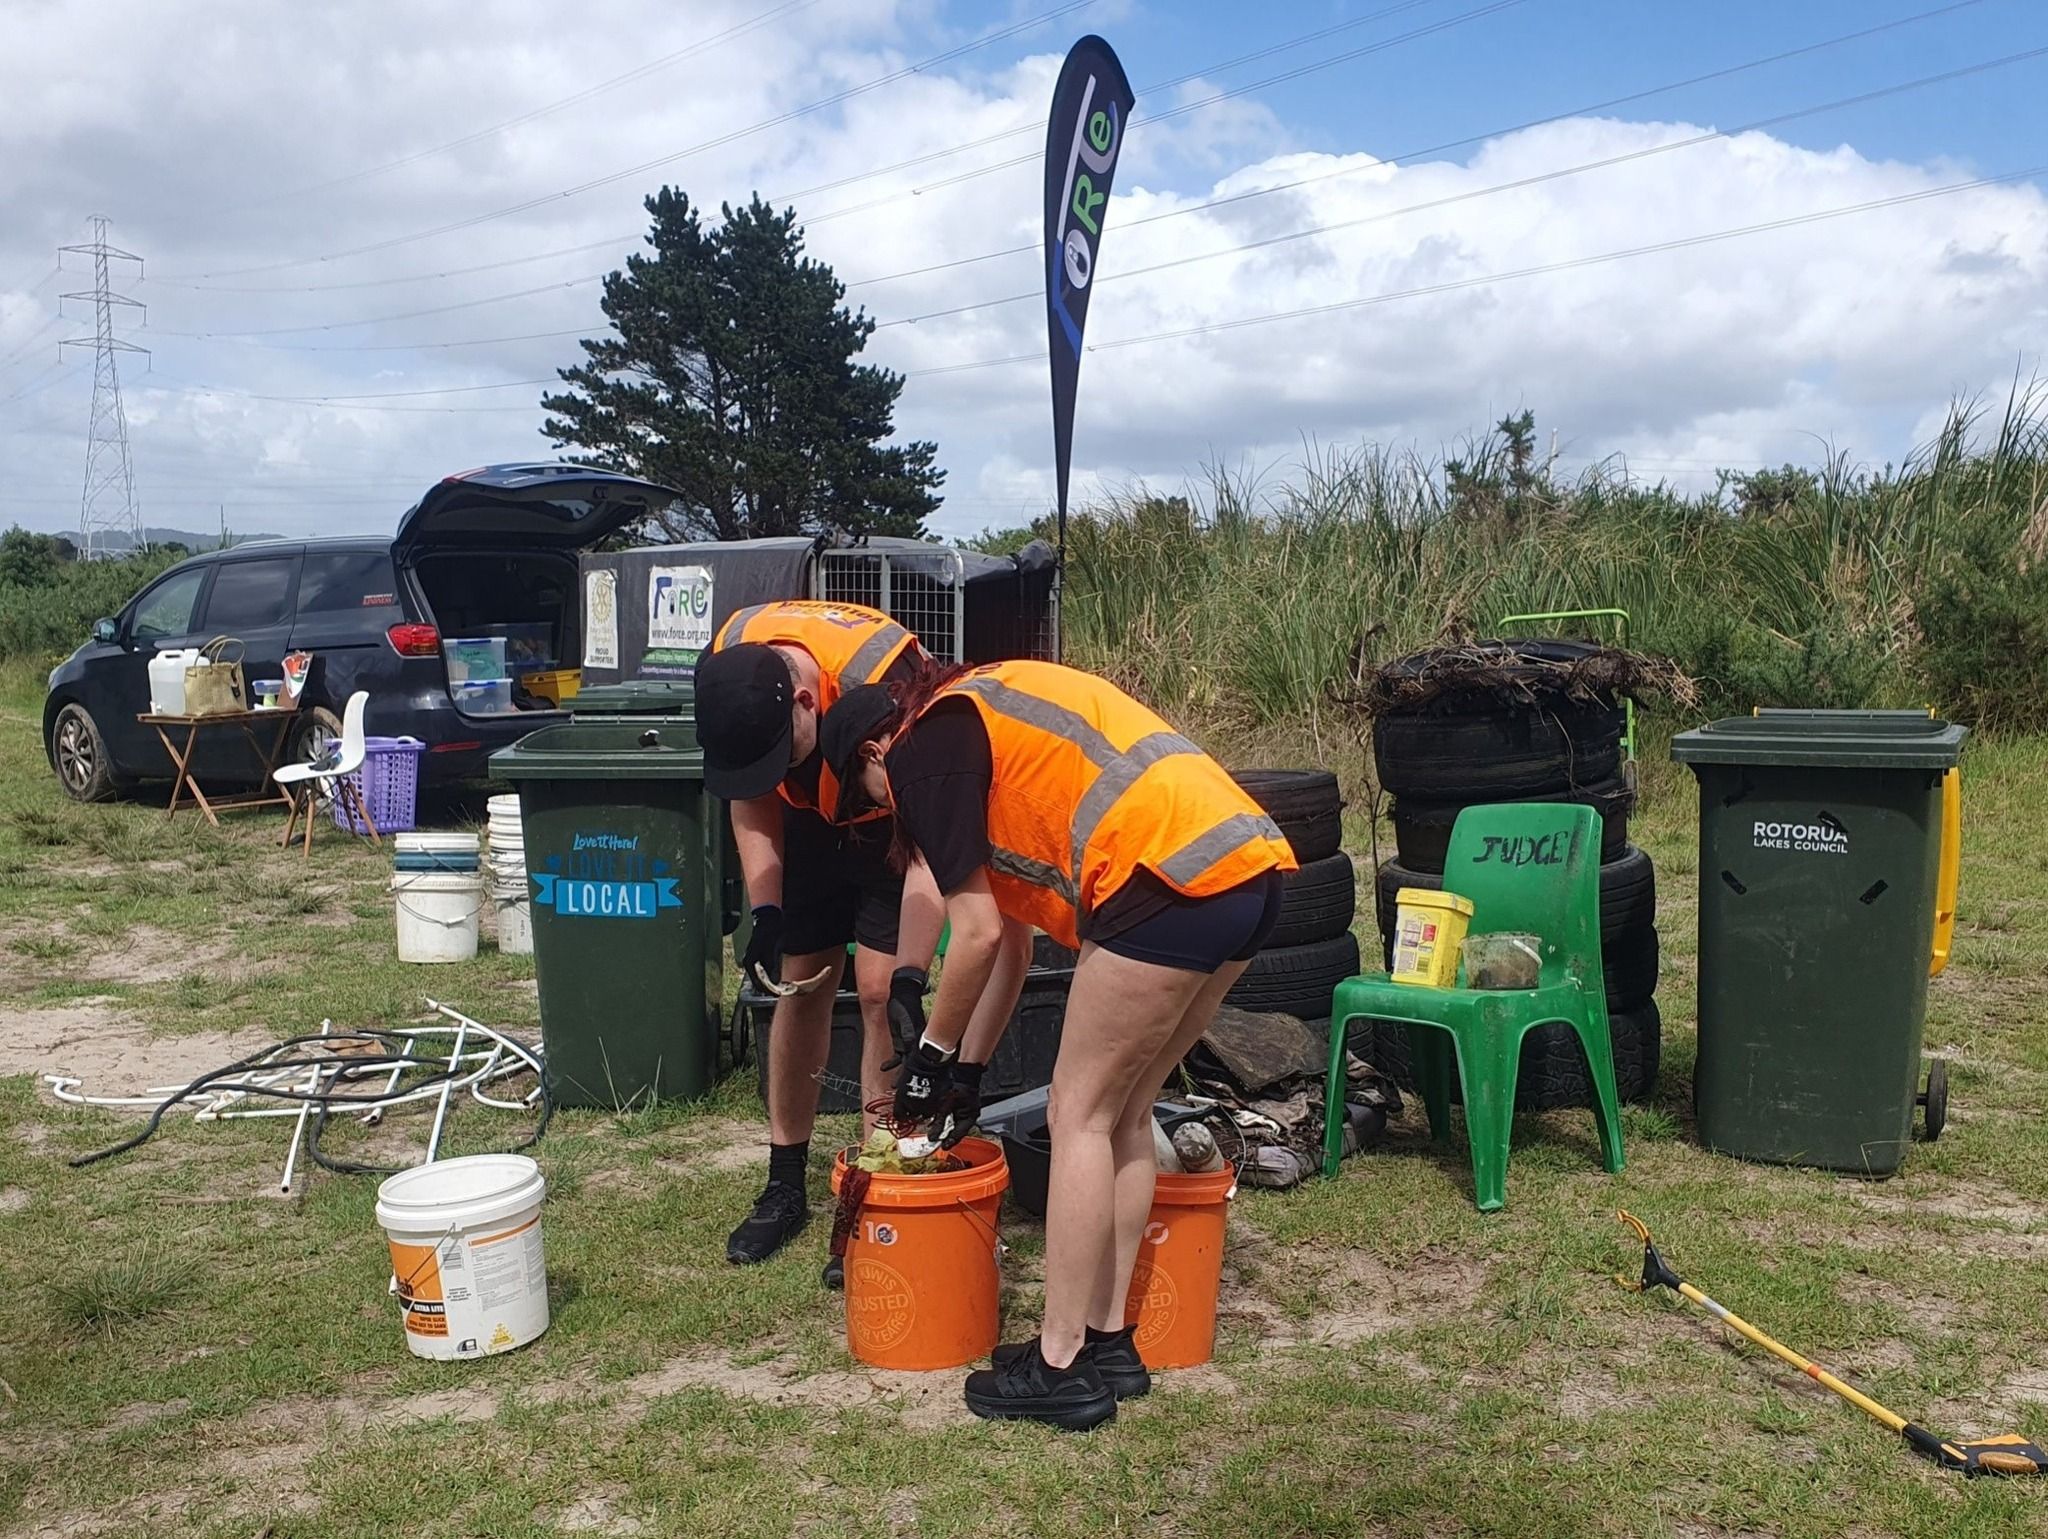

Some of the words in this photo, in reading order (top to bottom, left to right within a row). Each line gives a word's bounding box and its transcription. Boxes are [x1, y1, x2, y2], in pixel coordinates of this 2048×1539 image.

[573, 833, 597, 851] Love
[1753, 821, 1848, 843] ROTORUA
[1472, 831, 1568, 866] JUDGE
[1753, 838, 1790, 849] LAKES
[1794, 840, 1848, 854] COUNCIL
[568, 854, 618, 880] LOVE
[568, 883, 647, 914] LOCAL
[1127, 1292, 1172, 1311] STED
[872, 1311, 908, 1342] YEARS
[1138, 1310, 1169, 1341] EARS
